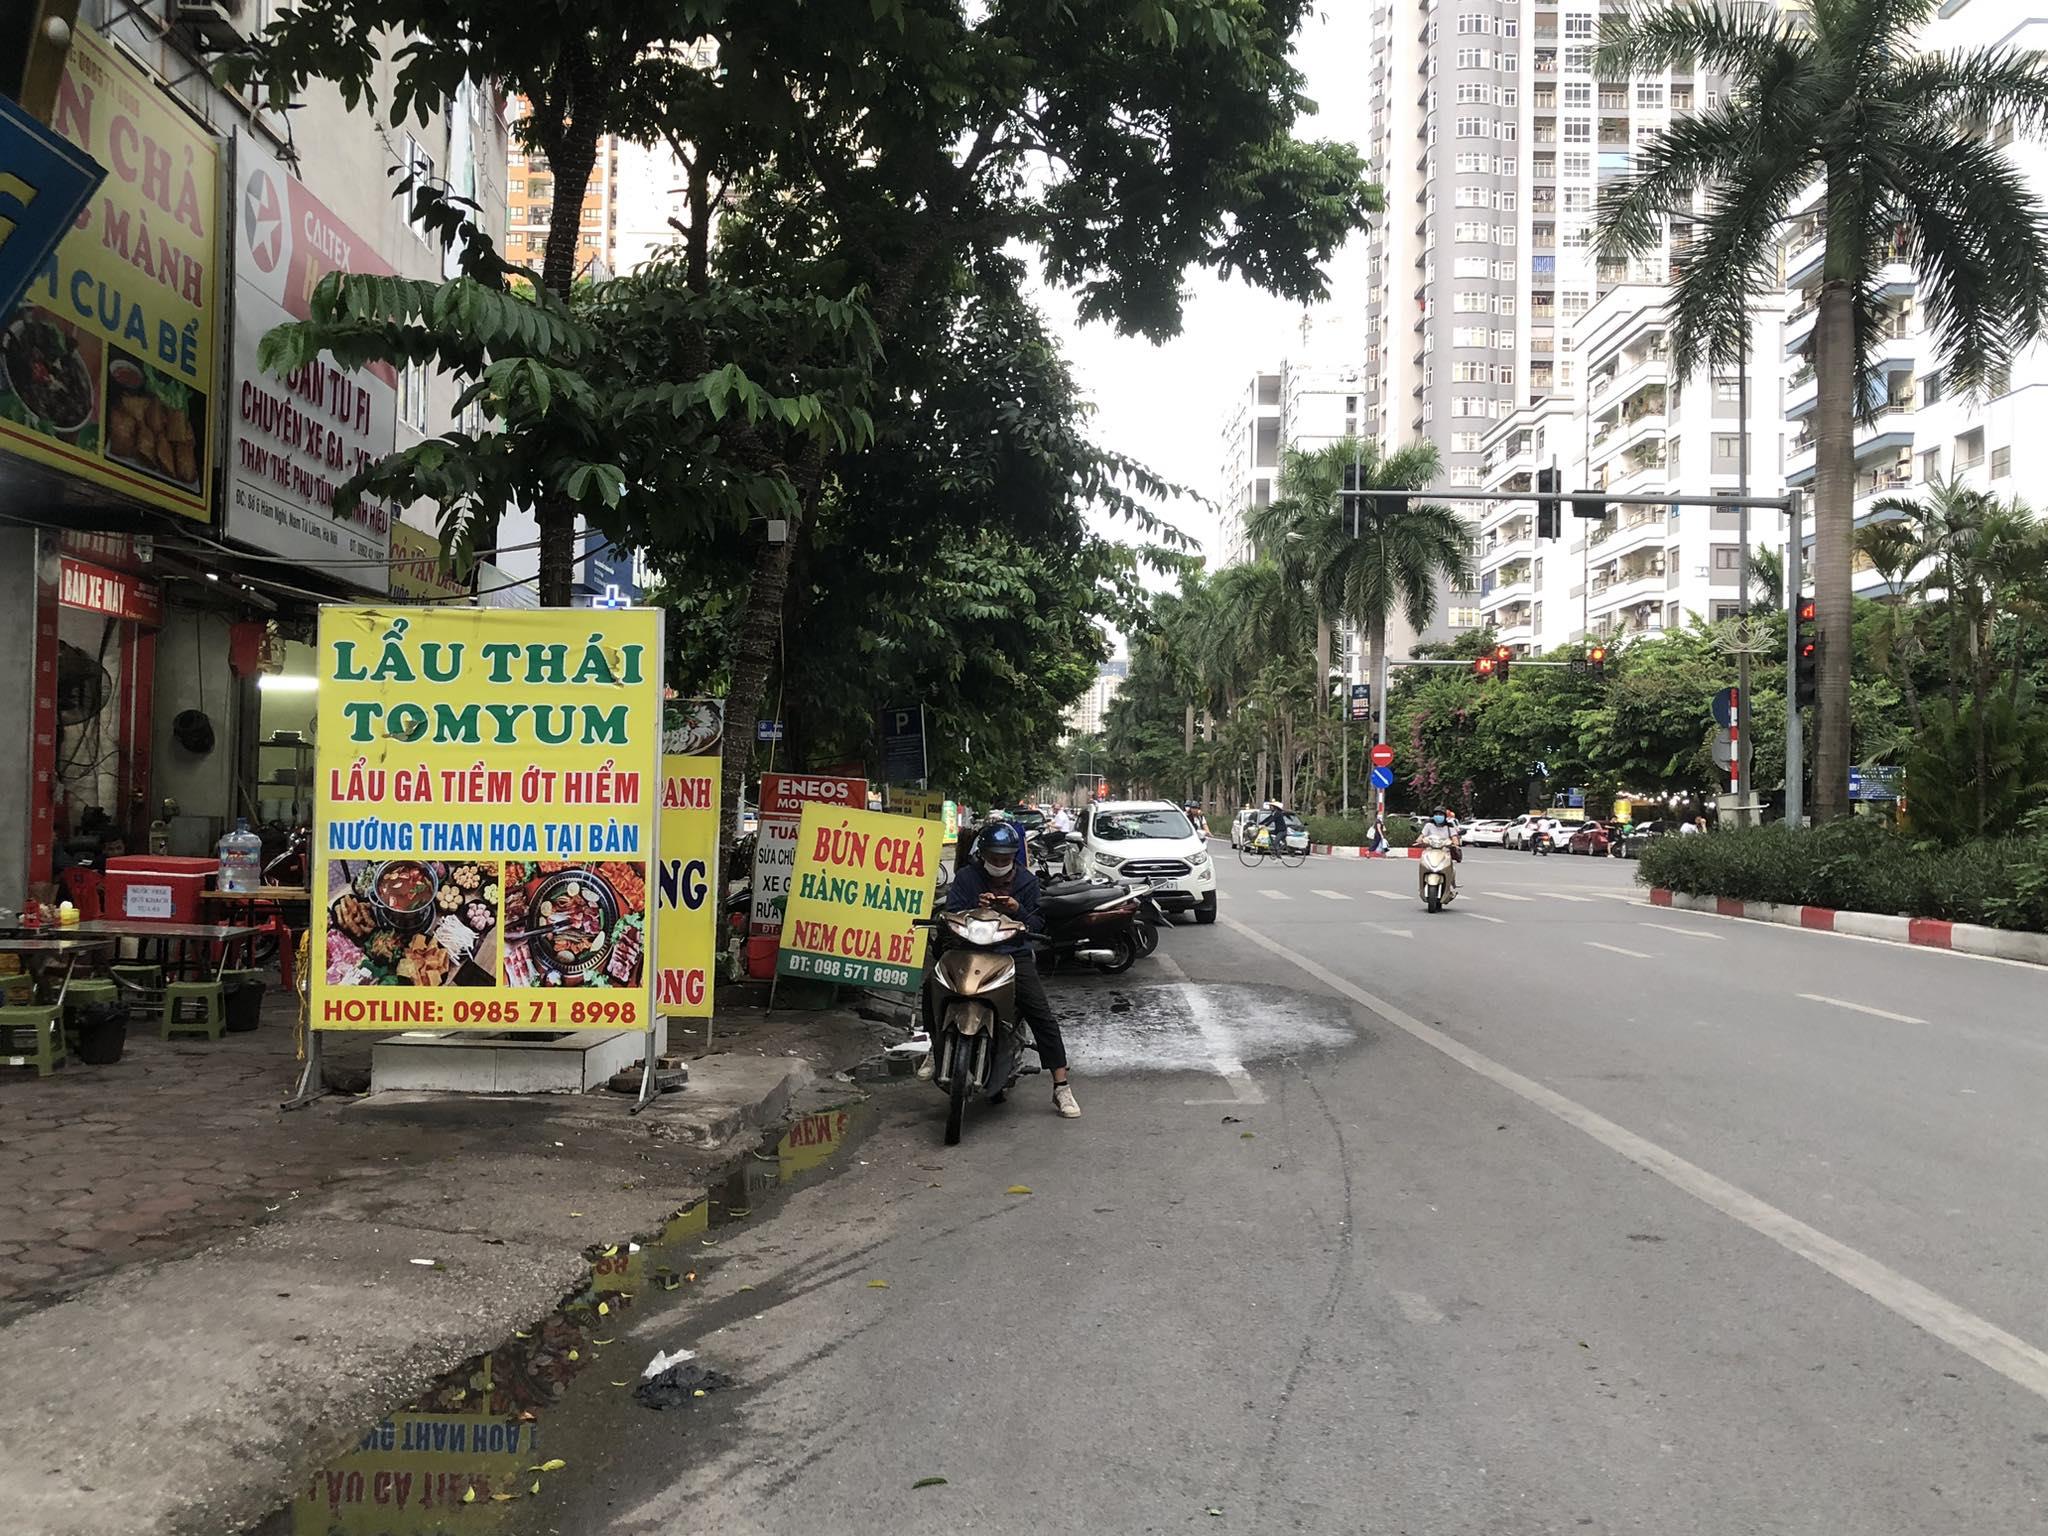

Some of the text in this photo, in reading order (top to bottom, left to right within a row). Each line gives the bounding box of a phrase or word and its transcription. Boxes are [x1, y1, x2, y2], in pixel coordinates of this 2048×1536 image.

[110, 115, 203, 237] CHẢ
[102, 198, 203, 308] MÀNH
[304, 211, 351, 274] CALTEX
[71, 270, 147, 350] CUA
[158, 318, 199, 376] BỂ
[240, 380, 302, 449] CHUYÊN
[304, 417, 323, 460] XE
[326, 431, 343, 471] GA
[240, 437, 269, 476] THAY
[271, 452, 291, 487] THẾ
[292, 465, 314, 504] PHỤ
[64, 564, 87, 605] BÁN
[88, 575, 102, 608] XE
[103, 575, 125, 614] MÁY
[333, 618, 644, 684] LẨU THÁI
[344, 702, 630, 744] TOMYUM
[895, 712, 909, 734] P
[331, 758, 639, 804] LẨU GÀ TIỀM ỚT HIỂM
[777, 779, 849, 799] ENEOS
[329, 816, 638, 859] NƯỚNG THAN HOA TẠI BÀN
[758, 845, 776, 865] SỬA
[812, 820, 925, 877] BÚN CHẢ
[762, 875, 779, 892] XE
[800, 869, 924, 915] HÀNG MÀNH
[762, 924, 778, 934] ĐT:
[792, 919, 838, 953] NEM
[841, 926, 881, 960] CUA
[789, 955, 908, 986] ĐT: 098 571 8998
[324, 1000, 636, 1024] HOTLINE: 0985 71 8998
